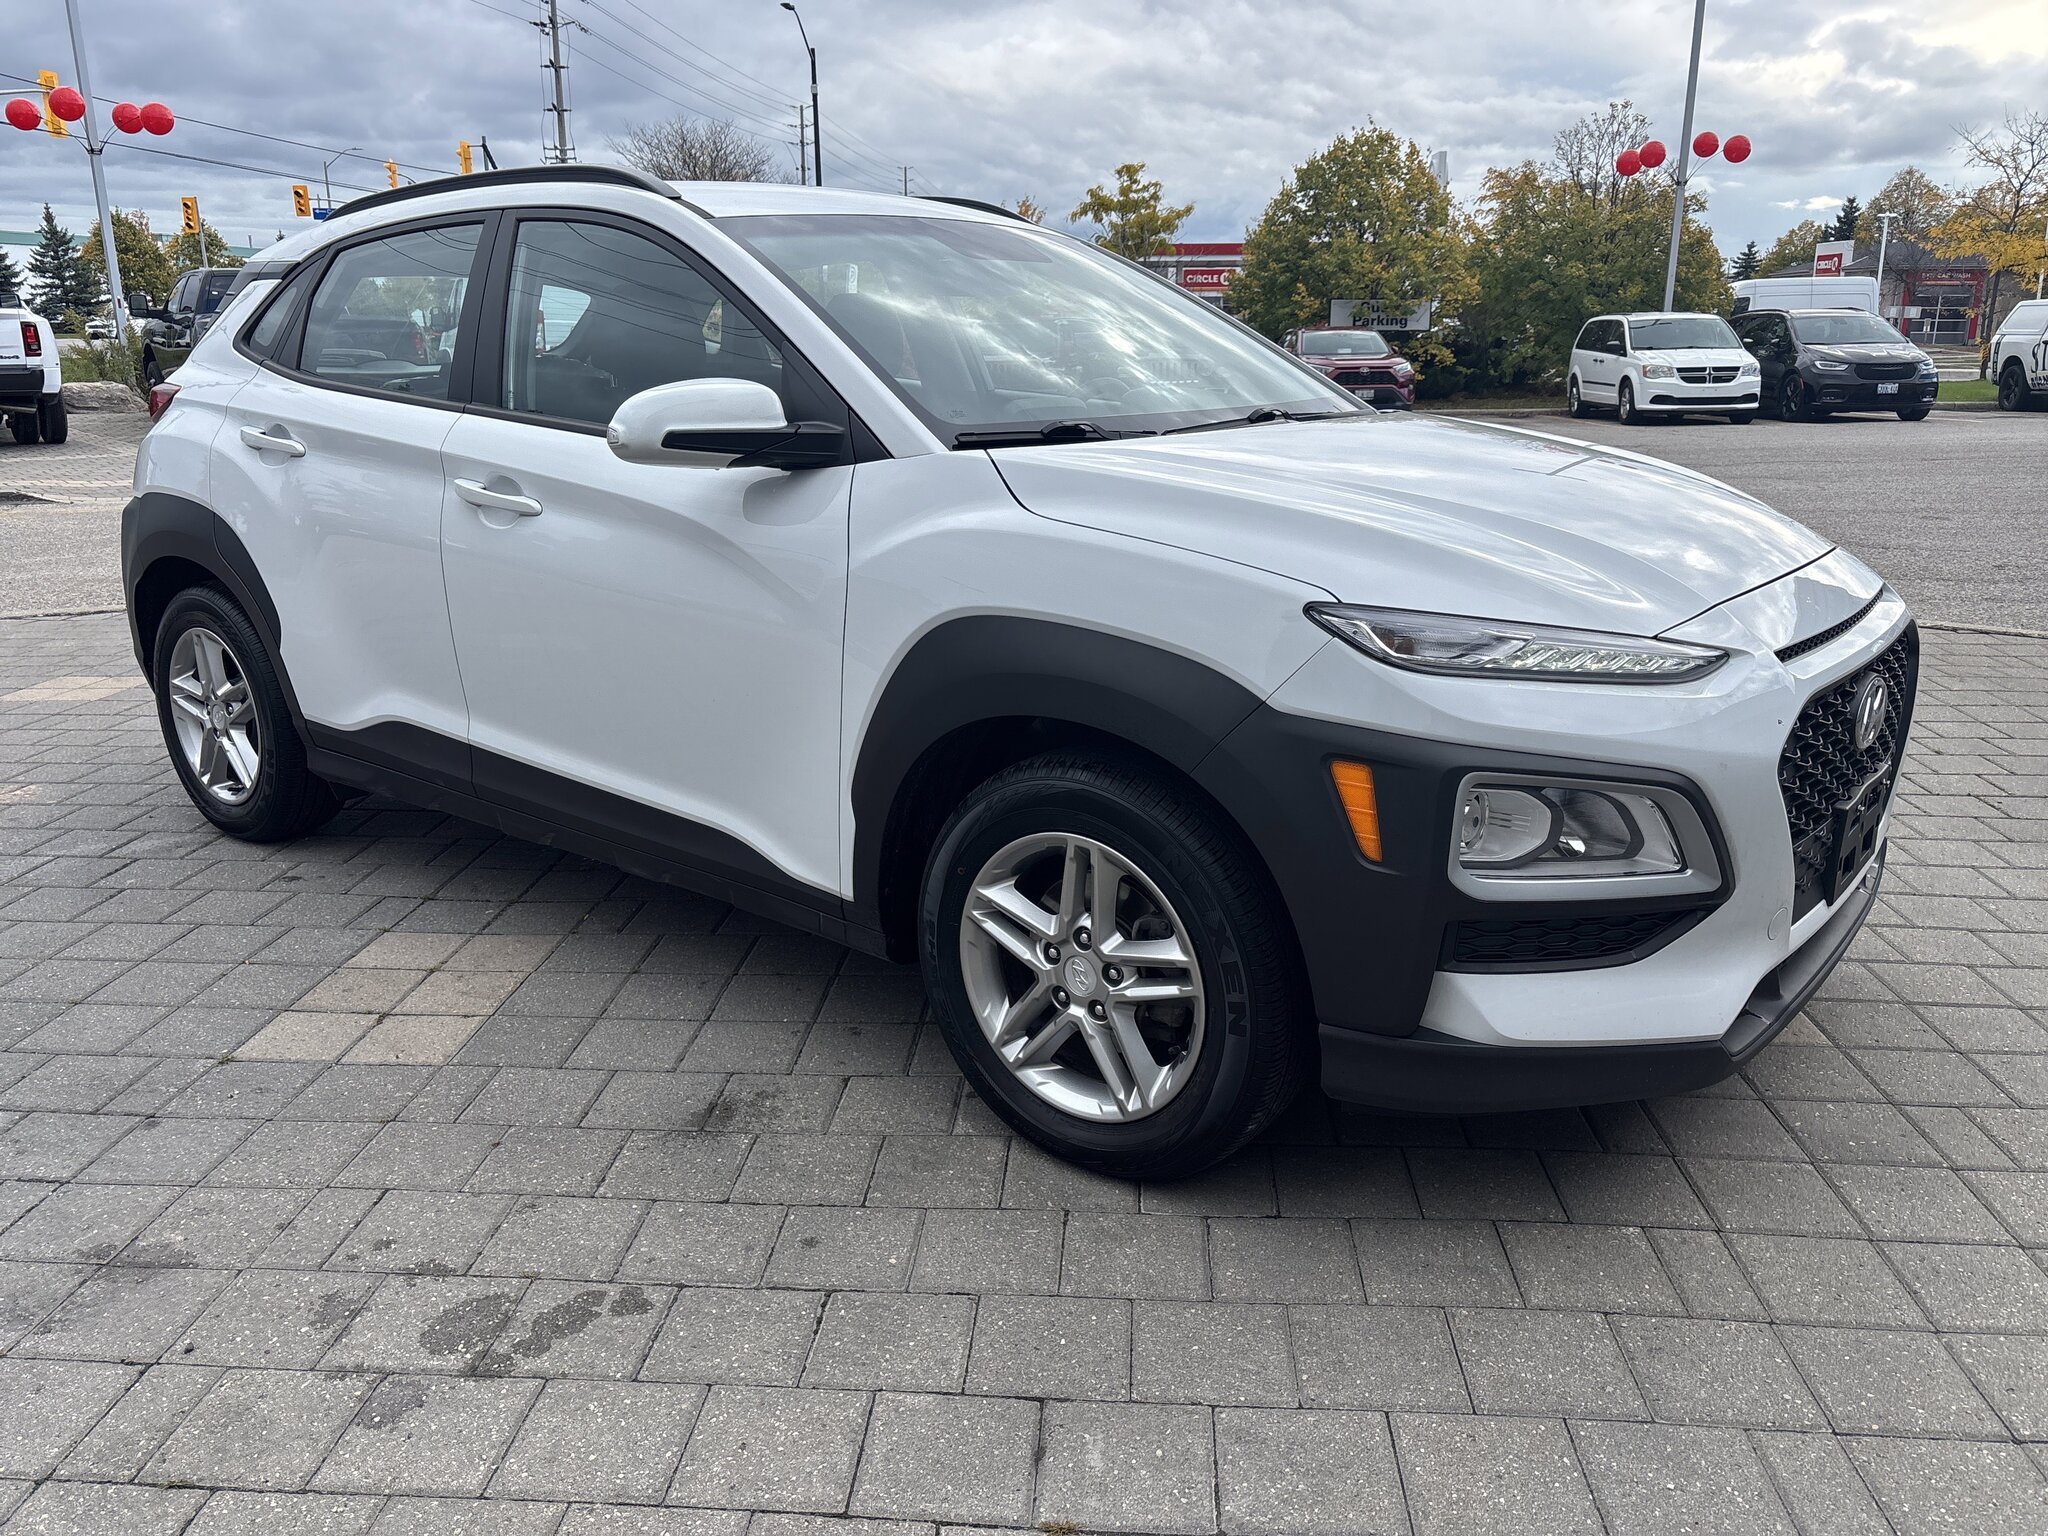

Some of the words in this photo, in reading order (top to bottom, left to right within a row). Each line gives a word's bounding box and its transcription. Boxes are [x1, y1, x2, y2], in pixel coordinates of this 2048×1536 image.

[1816, 260, 1832, 269] CIRCLE
[1186, 274, 1219, 283] CIRCLE
[1353, 314, 1409, 328] Parking
